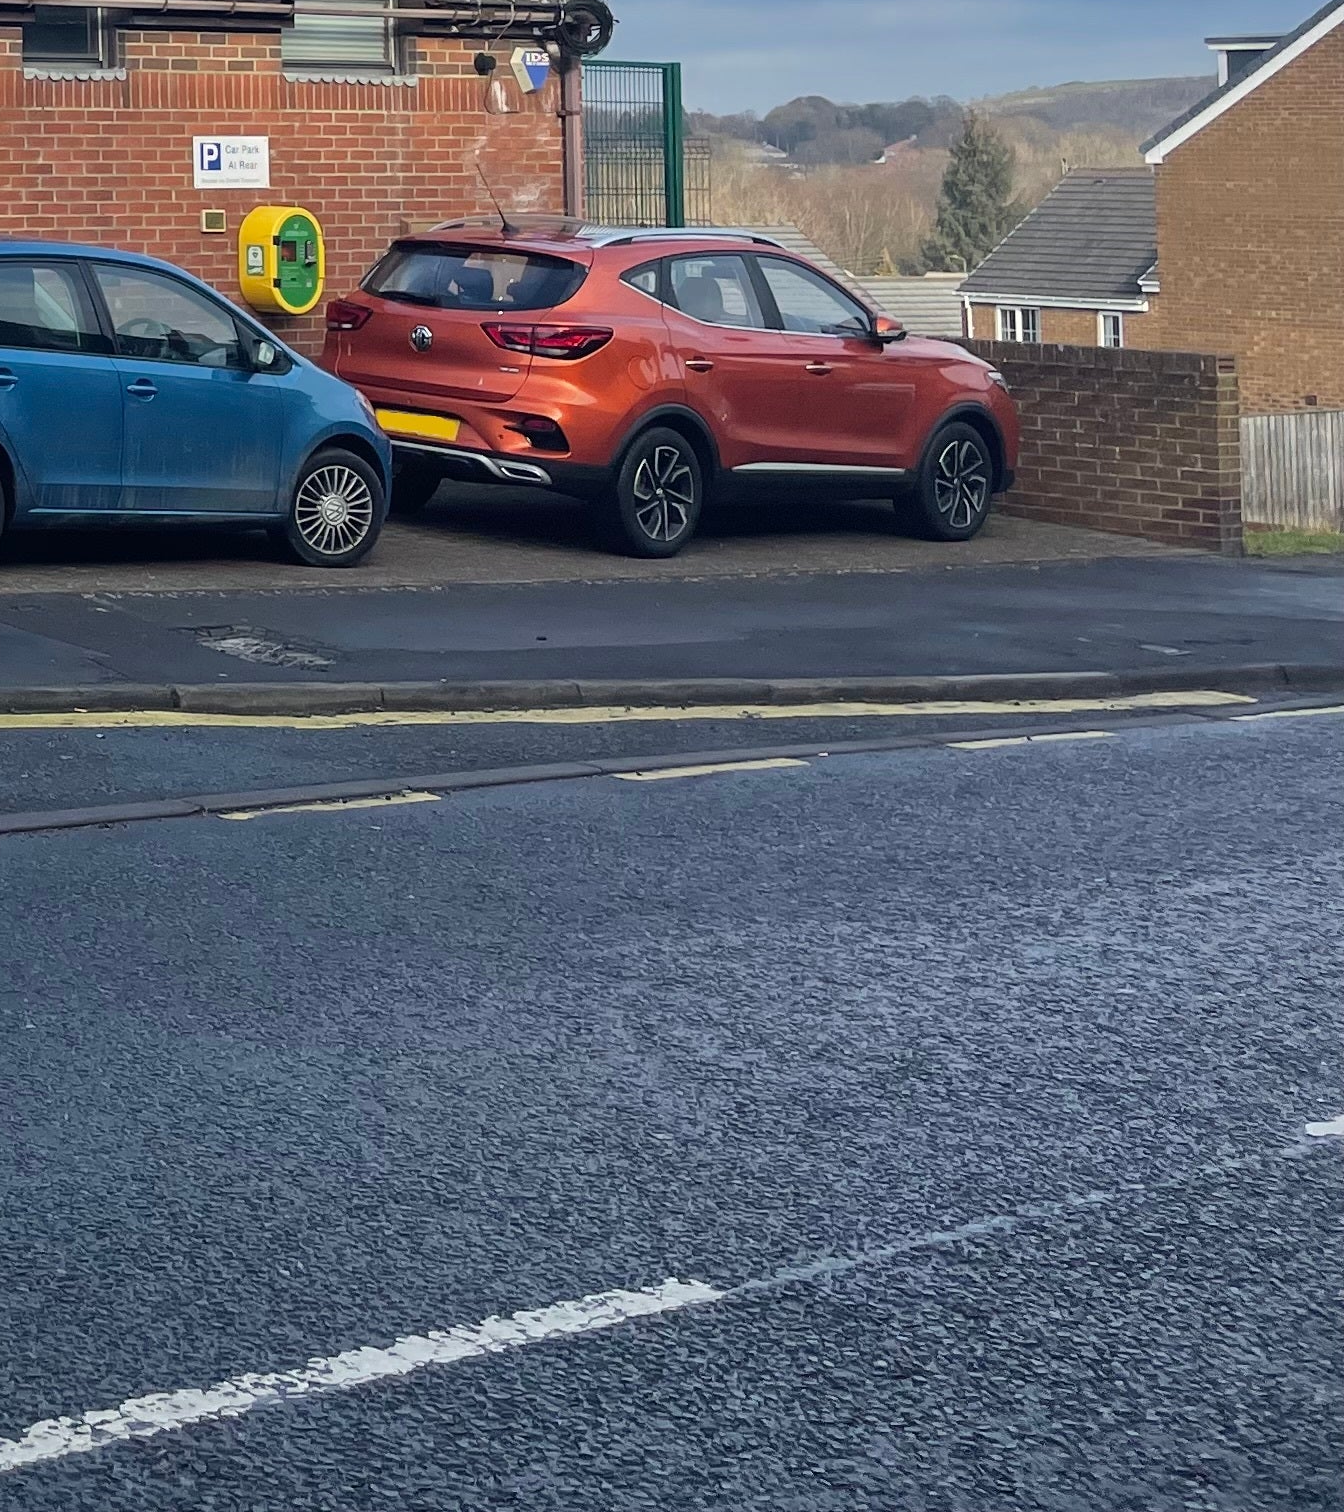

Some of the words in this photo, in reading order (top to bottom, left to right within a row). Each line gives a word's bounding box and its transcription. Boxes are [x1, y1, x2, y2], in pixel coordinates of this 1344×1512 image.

[526, 53, 549, 62] IDS
[225, 145, 239, 154] Car
[241, 145, 260, 154] Park
[203, 143, 218, 170] P
[239, 161, 258, 169] Rear
